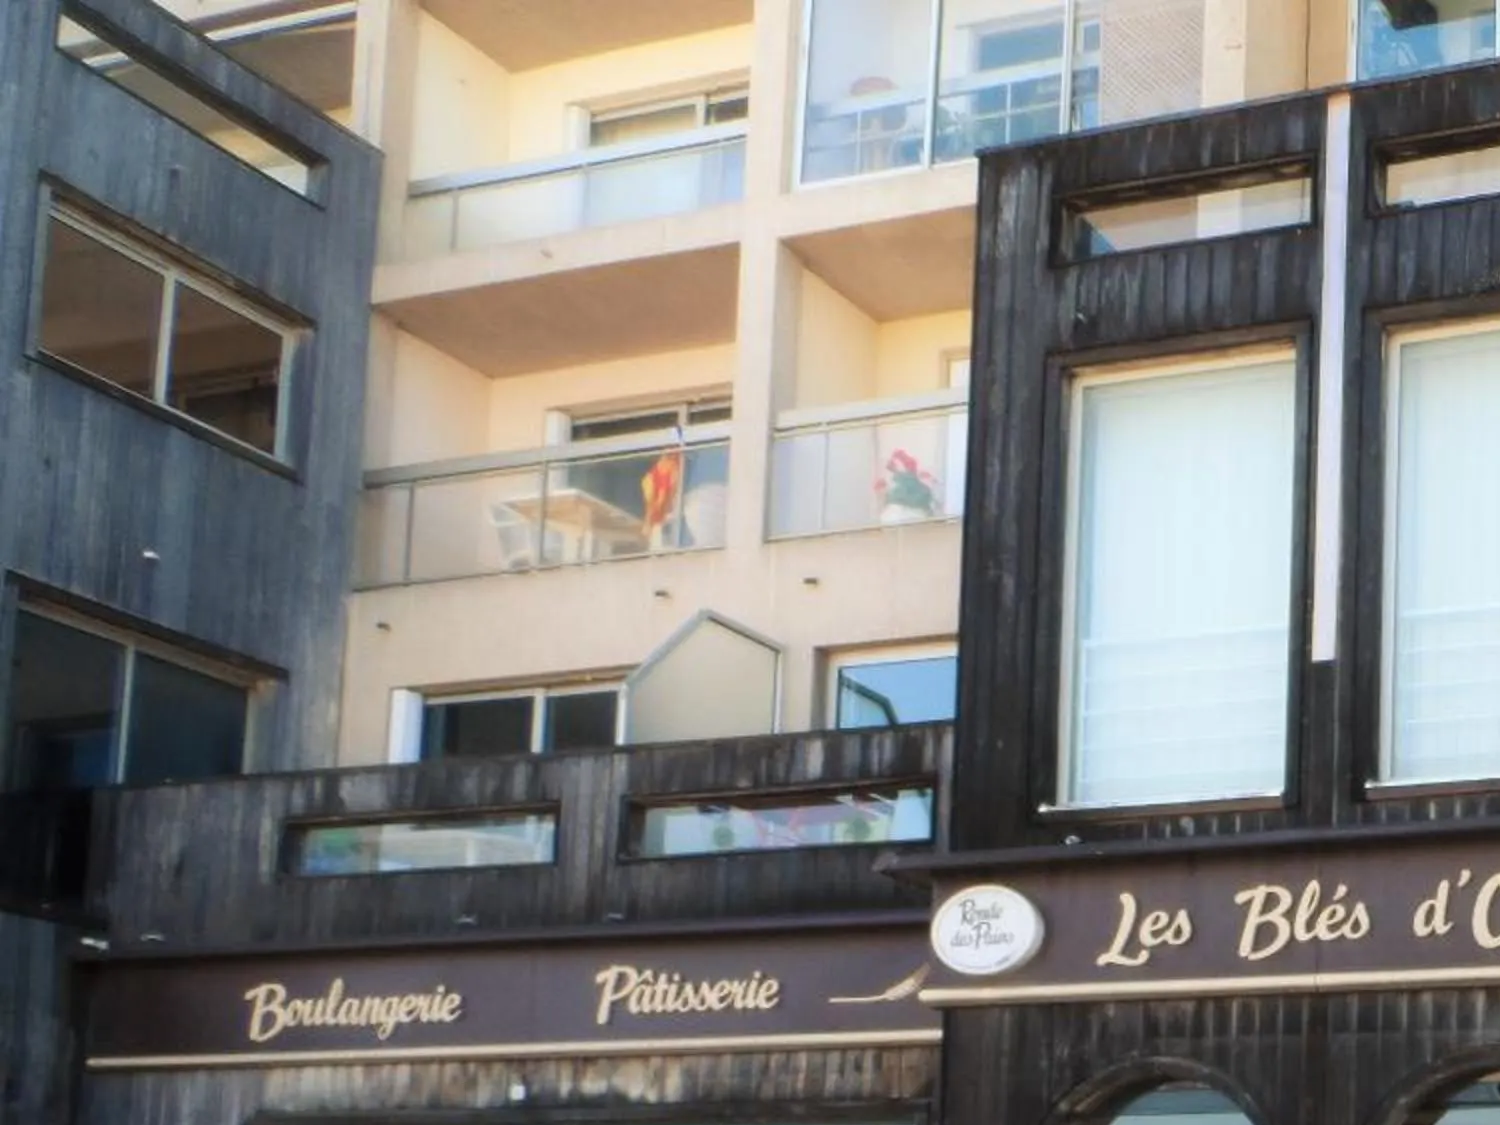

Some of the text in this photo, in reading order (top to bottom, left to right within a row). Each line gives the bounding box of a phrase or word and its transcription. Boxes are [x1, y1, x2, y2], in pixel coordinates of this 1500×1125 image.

[1096, 893, 1192, 966] Les
[1234, 879, 1370, 961] Blés
[244, 978, 463, 1042] Boulangerie
[595, 964, 780, 1025] Pâtisserie
